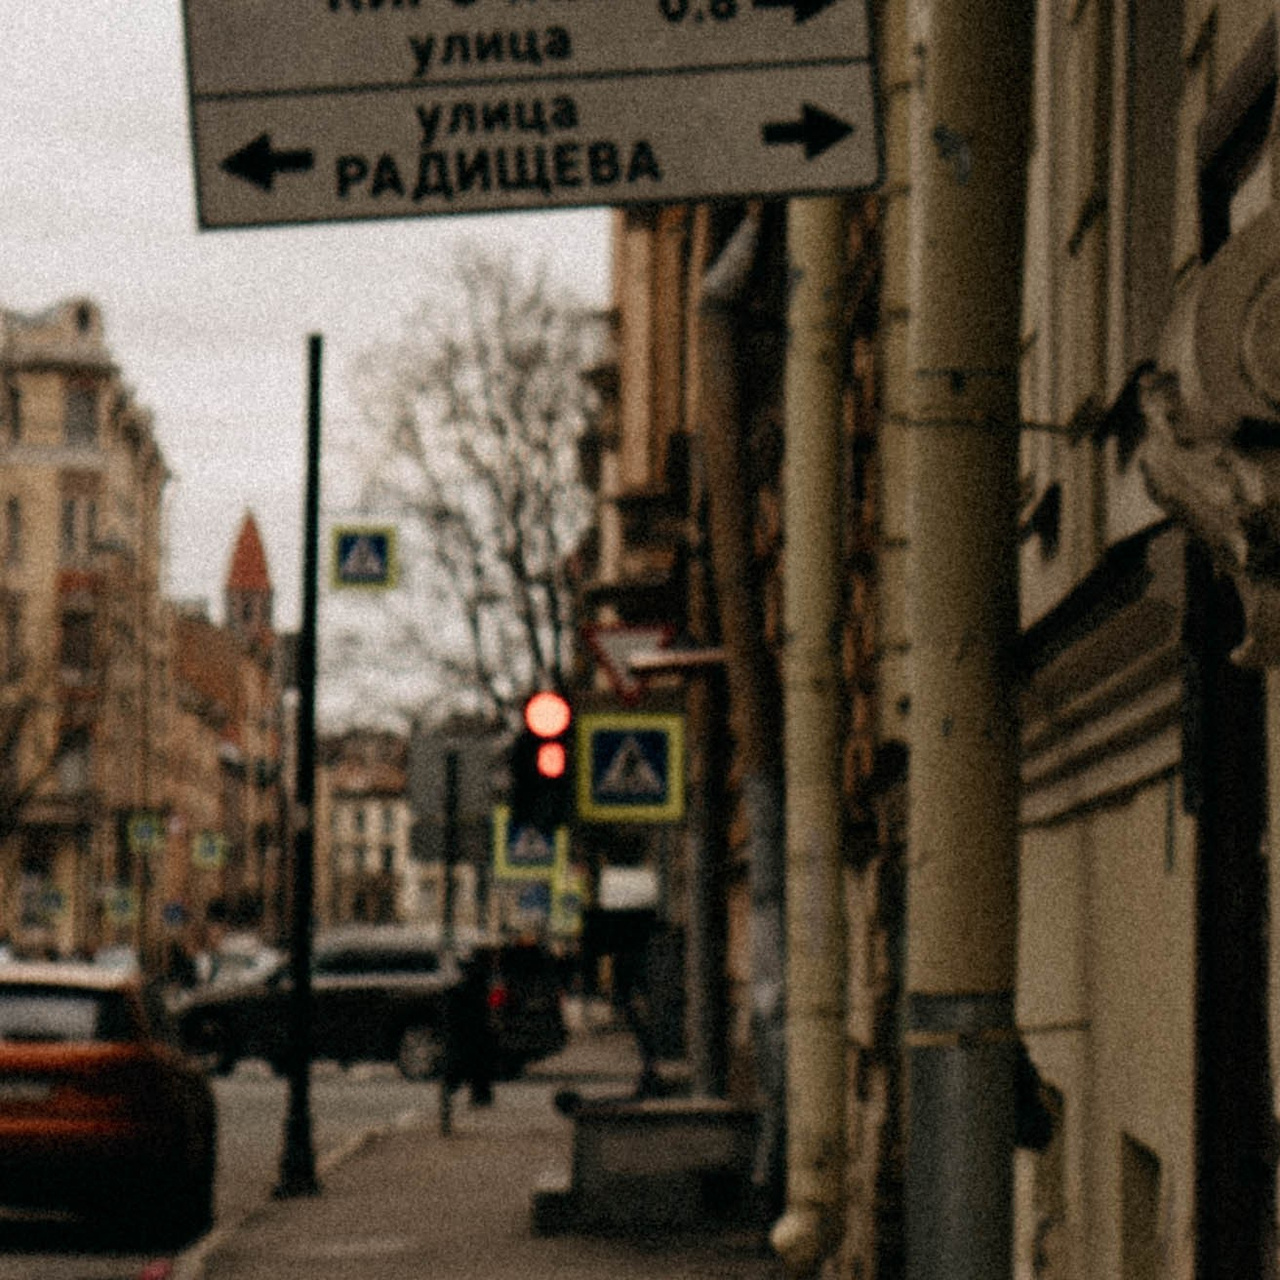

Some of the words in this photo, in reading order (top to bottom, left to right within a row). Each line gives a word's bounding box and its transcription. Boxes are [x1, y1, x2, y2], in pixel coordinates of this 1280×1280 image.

[409, 24, 572, 76] улица
[416, 95, 579, 146] улица
[336, 140, 663, 201] РАДИЩЕВА
